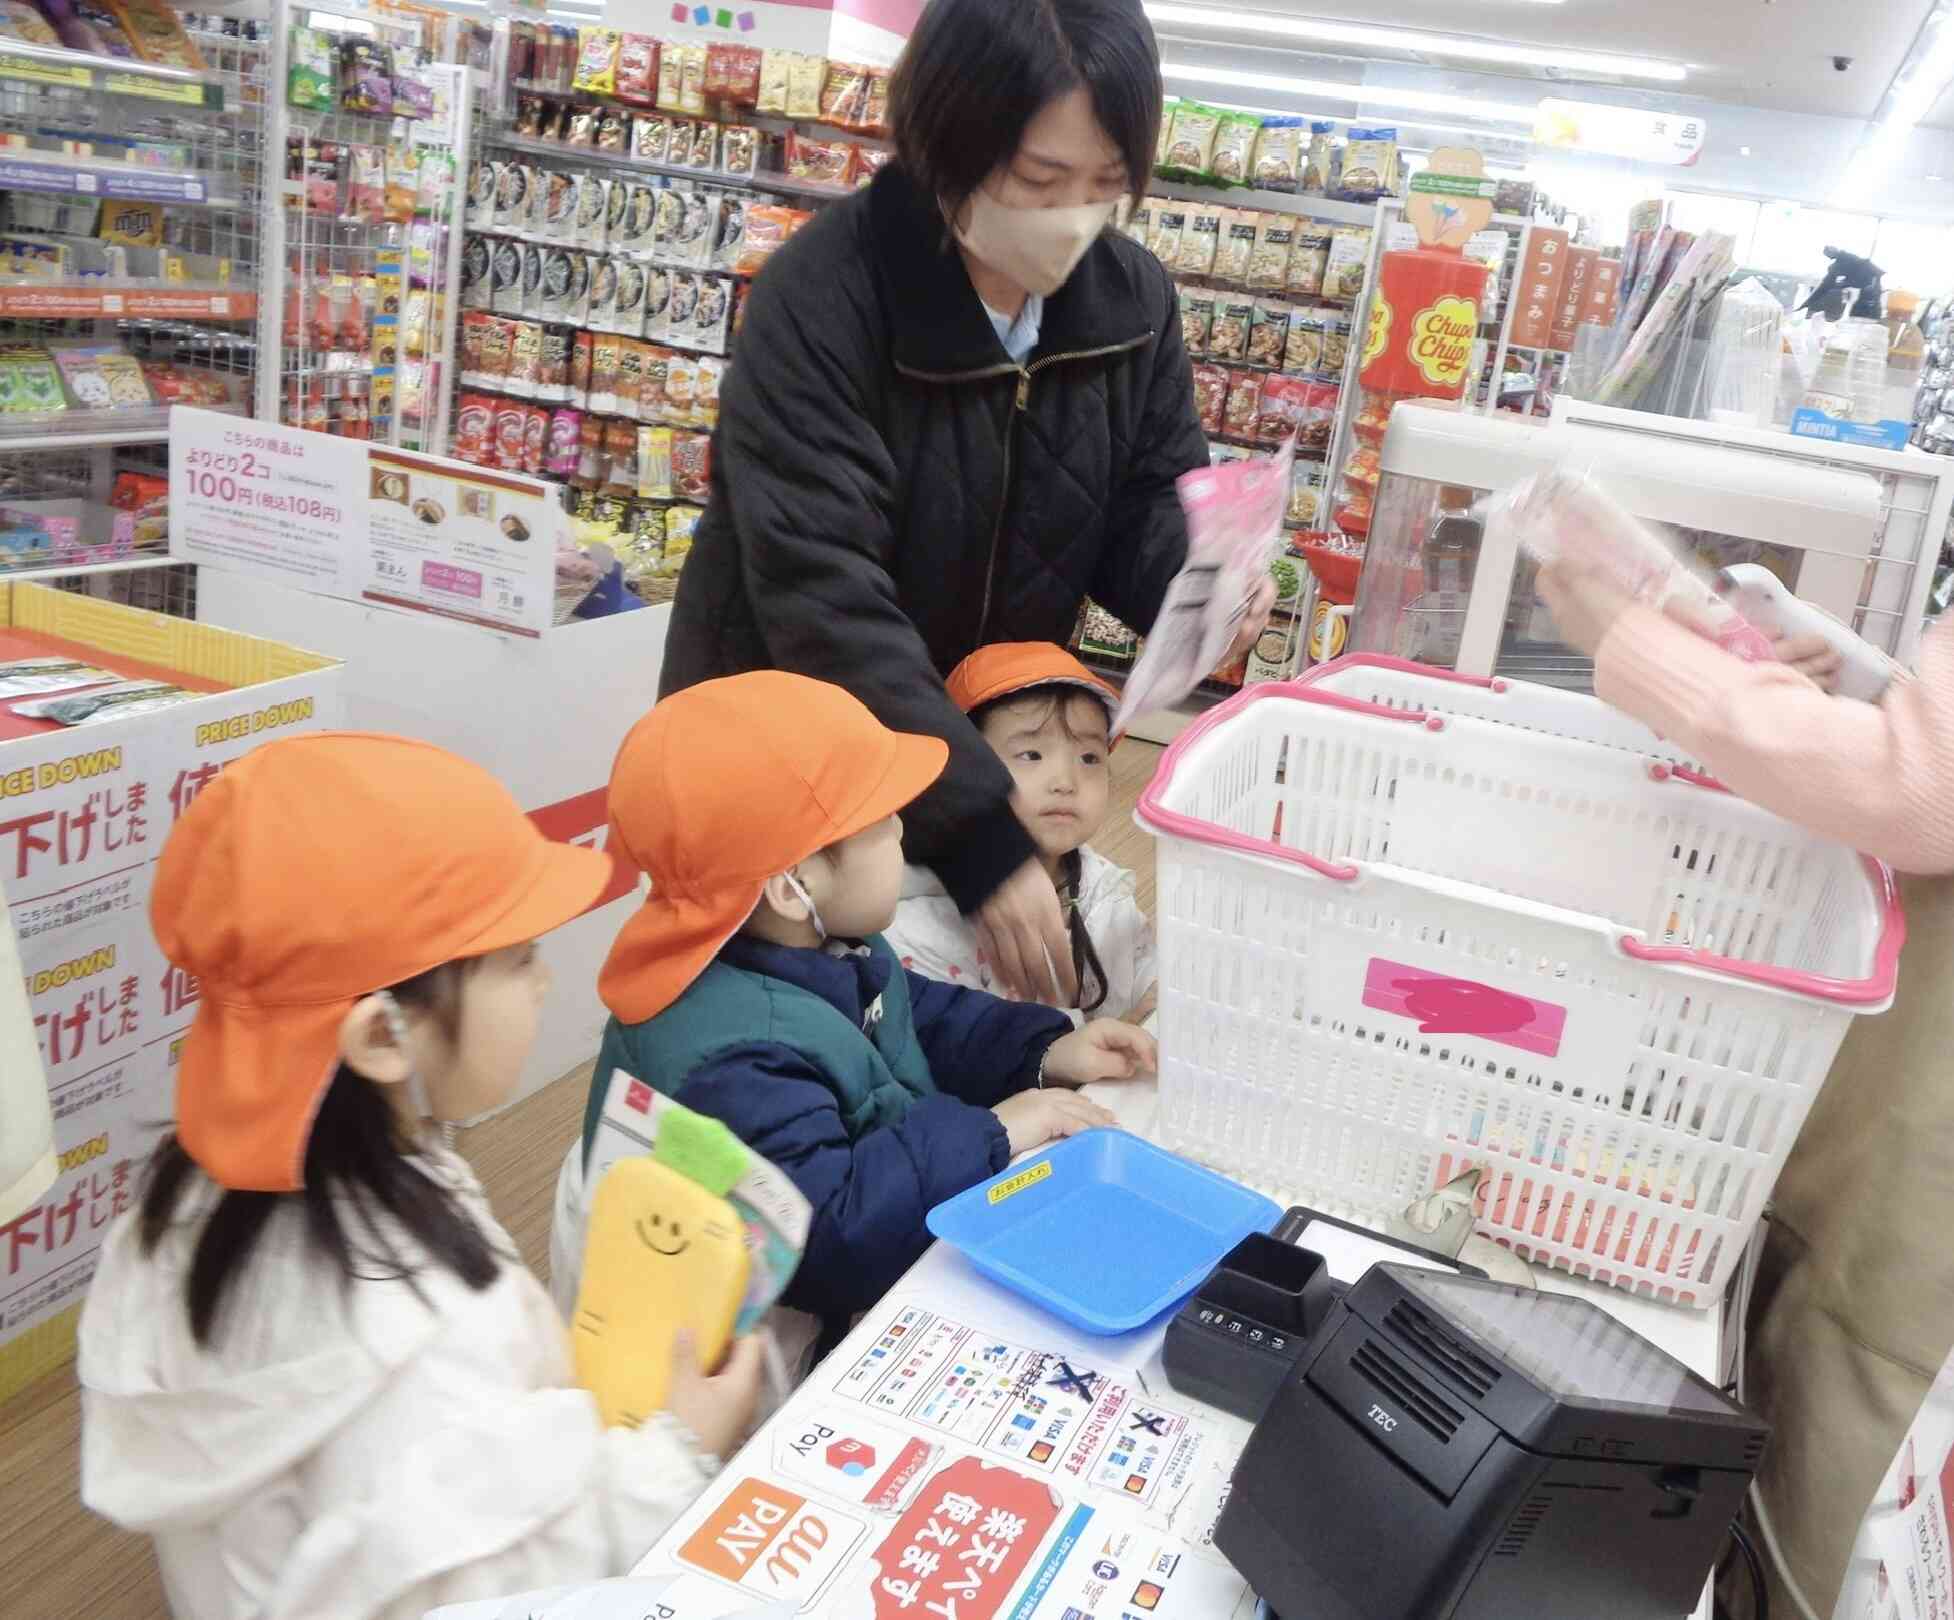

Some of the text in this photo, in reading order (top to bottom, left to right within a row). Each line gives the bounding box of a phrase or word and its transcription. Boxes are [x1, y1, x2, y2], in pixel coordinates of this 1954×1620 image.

[1526, 239, 1558, 320] おつまみ
[186, 448, 271, 480] よりどり2コ
[223, 431, 305, 457] こちらの商品は
[196, 697, 314, 747] PRICE DOWN
[39, 745, 122, 790] DOWN
[32, 944, 116, 996] DOWN
[790, 1423, 835, 1457] Pay
[1043, 1418, 1068, 1440] VISA
[1065, 1384, 1128, 1476] ご利用いただけます
[1367, 1404, 1398, 1432] TEC
[1137, 1456, 1155, 1474] VISA
[715, 1497, 788, 1566] PAY
[766, 1515, 829, 1585] au
[881, 1491, 983, 1608] 使えます
[1155, 1553, 1174, 1574] VISA
